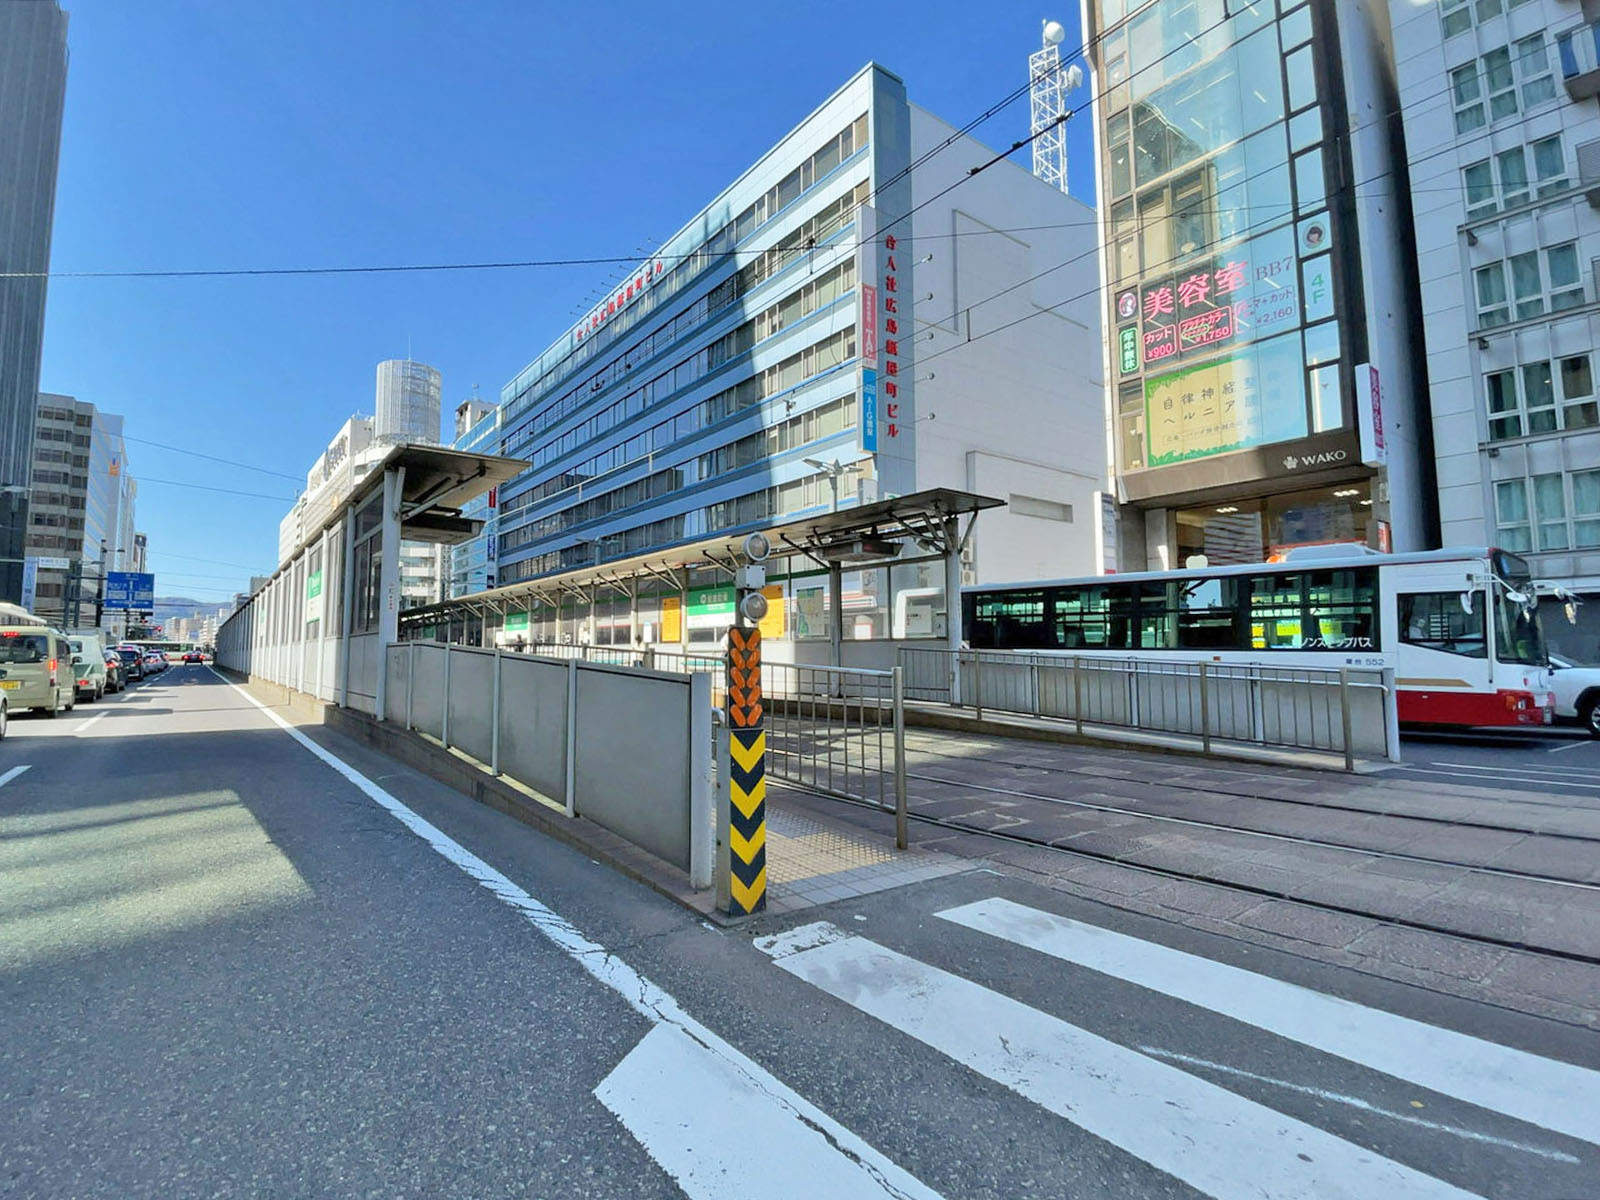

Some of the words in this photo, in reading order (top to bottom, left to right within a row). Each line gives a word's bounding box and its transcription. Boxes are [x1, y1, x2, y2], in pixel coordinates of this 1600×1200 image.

[1142, 260, 1249, 322] 美容室
[1256, 256, 1293, 280] BB7
[1301, 449, 1346, 466] WAKO
[1365, 658, 1385, 666] 552
